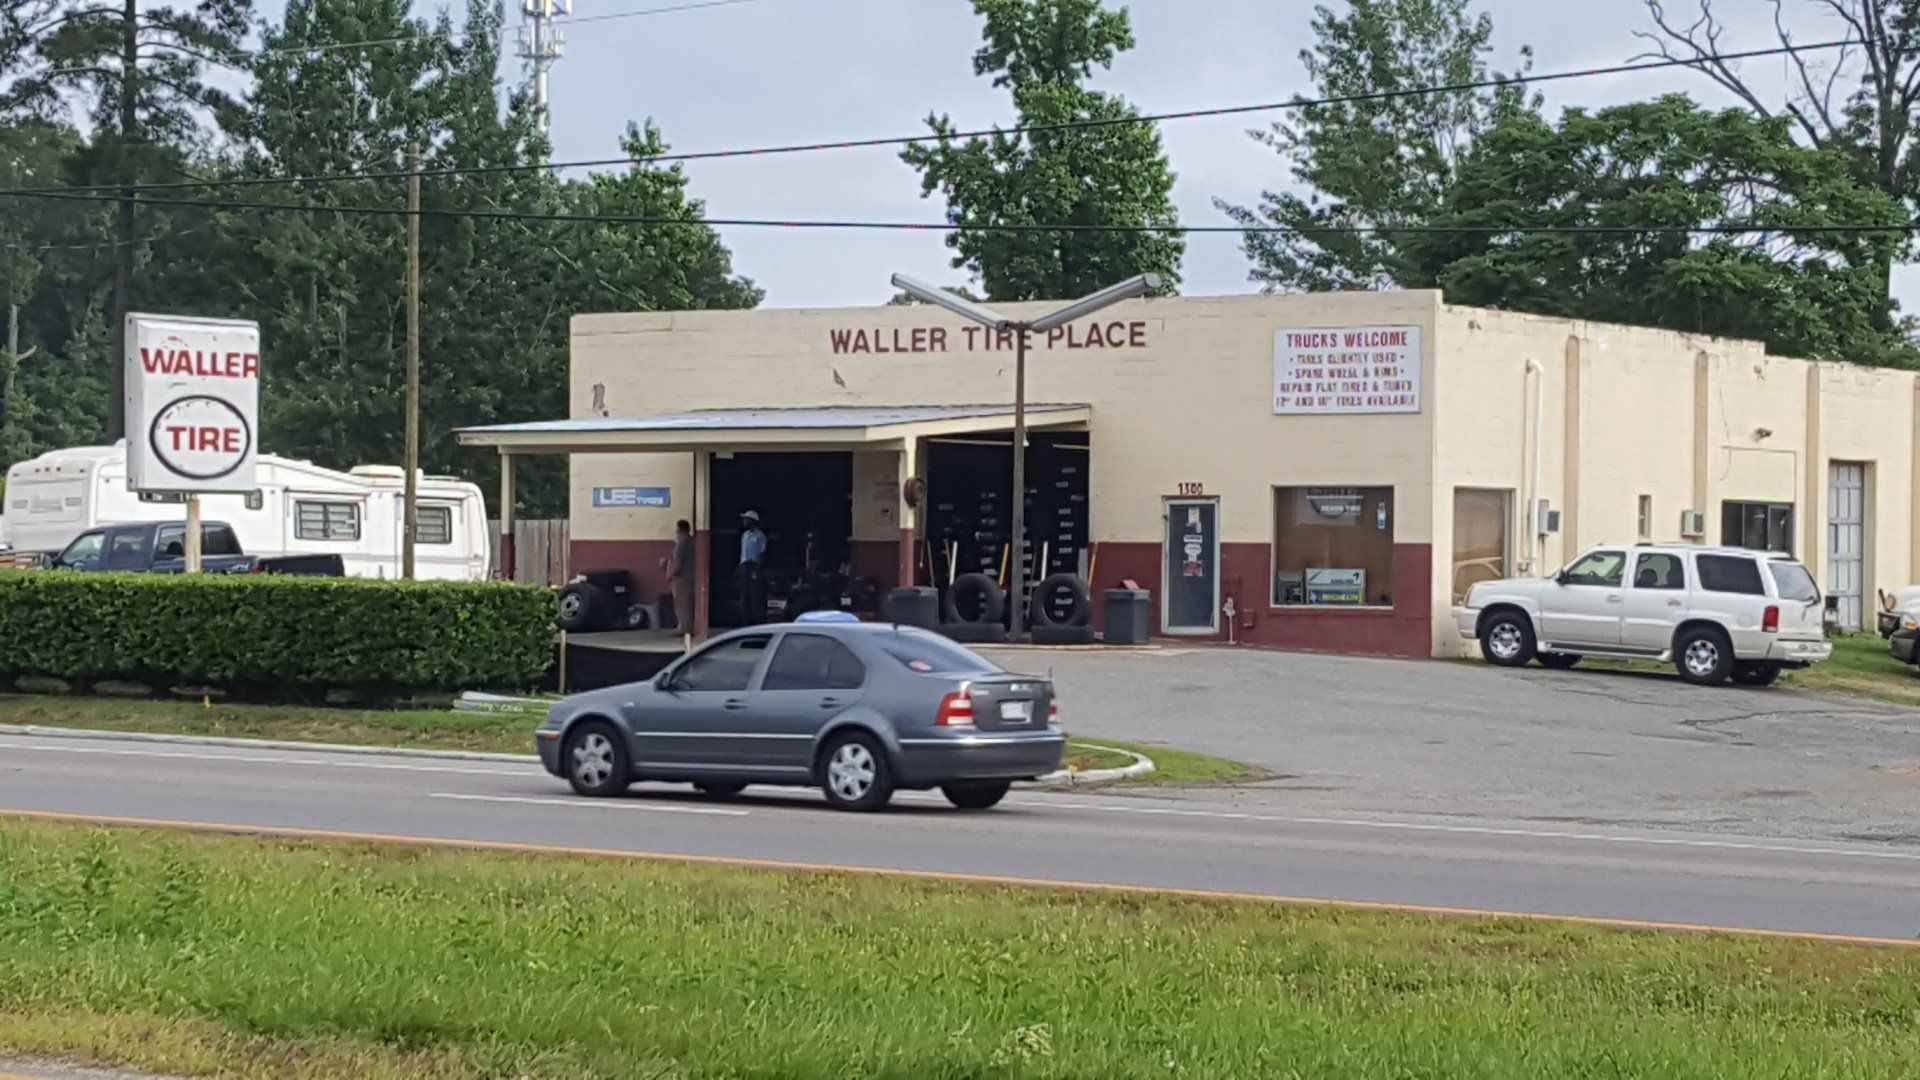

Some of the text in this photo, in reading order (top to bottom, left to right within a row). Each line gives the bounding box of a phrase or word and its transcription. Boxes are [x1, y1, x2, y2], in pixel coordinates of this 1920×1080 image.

[830, 326, 948, 354] WALLER
[1048, 321, 1146, 350] PLACE
[1286, 331, 1408, 348] TRUCKS WELCOME
[140, 347, 260, 379] WALLER
[1372, 351, 1397, 363] USED
[1280, 382, 1312, 393] REPAIR
[1316, 382, 1337, 393] FLAT
[1295, 396, 1314, 407] AND
[166, 426, 241, 453] TIRE
[1177, 482, 1203, 495] 1300
